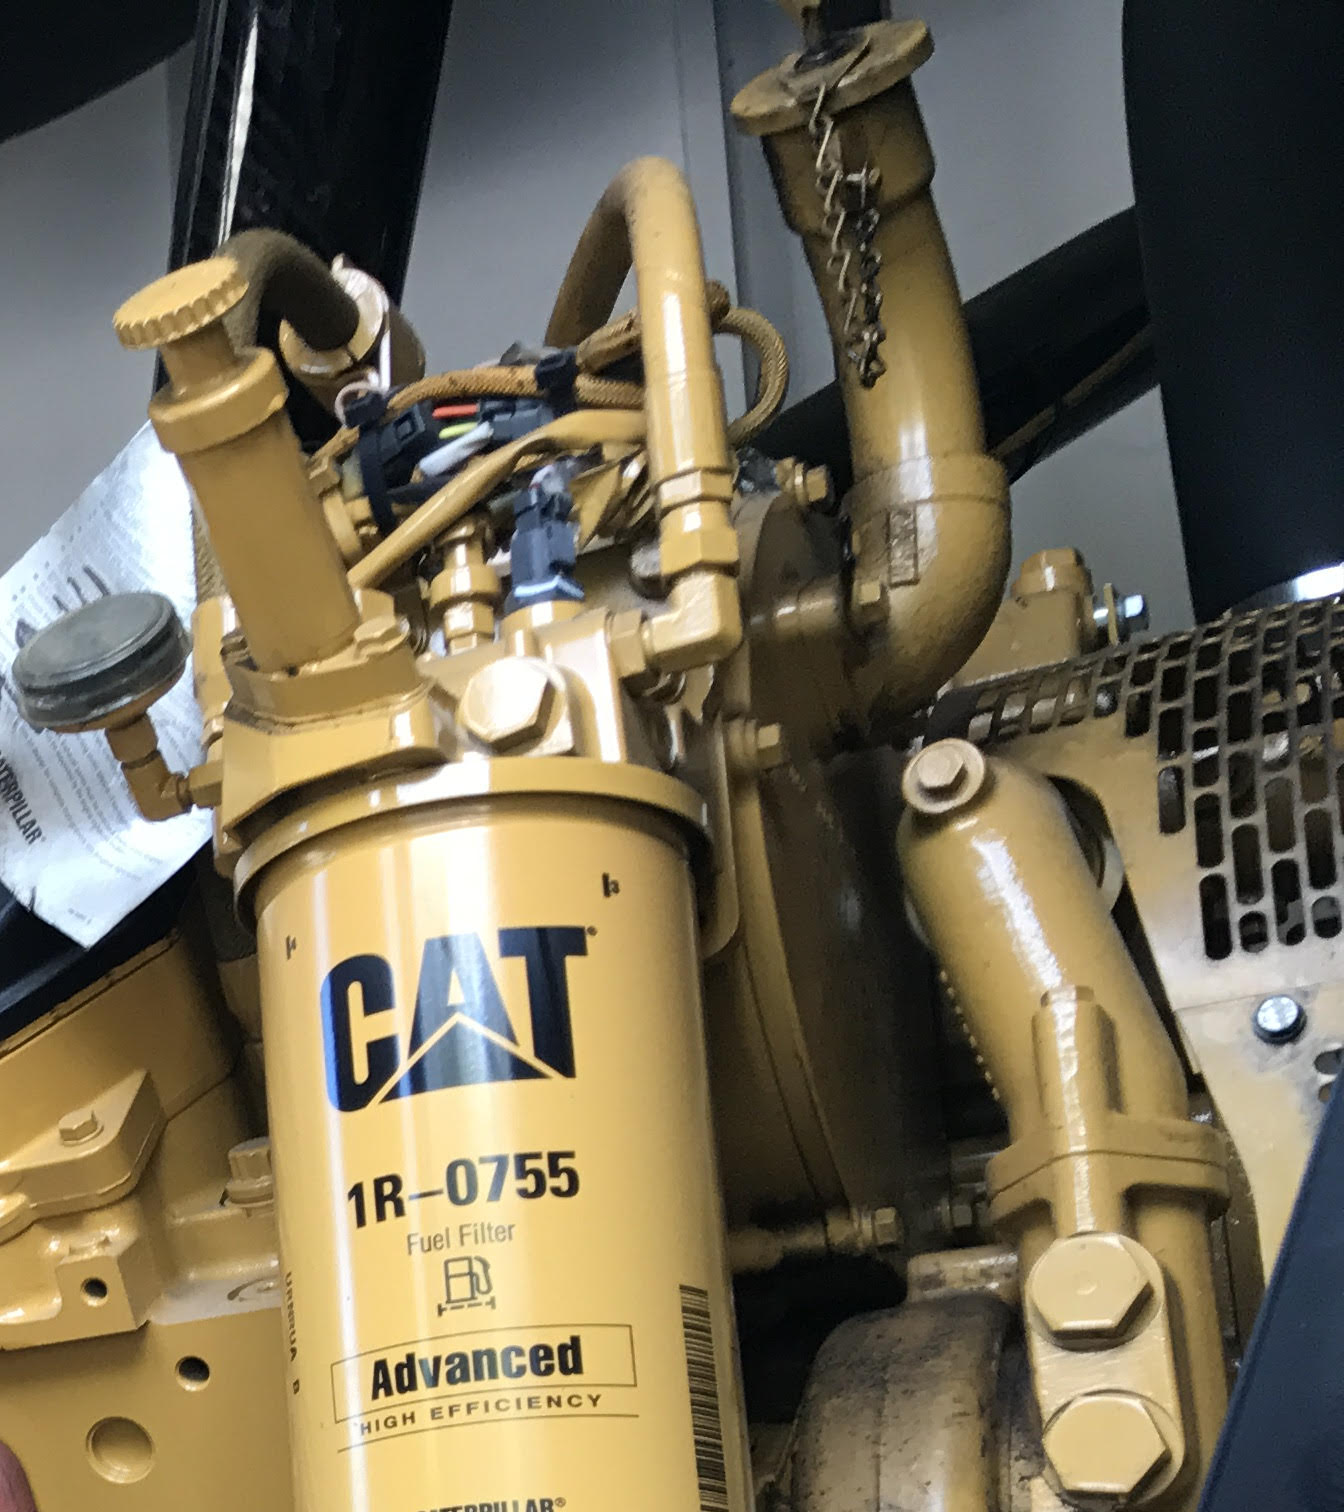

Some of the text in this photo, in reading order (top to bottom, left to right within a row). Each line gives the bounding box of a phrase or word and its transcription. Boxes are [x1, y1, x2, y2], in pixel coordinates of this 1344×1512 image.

[319, 925, 589, 1112] CAT
[347, 1151, 580, 1229] 1R-0755
[406, 1220, 516, 1256] Fuel Filter
[371, 1336, 584, 1402] Advanced
[359, 1392, 603, 1436] HIGH EFFICIENCY
